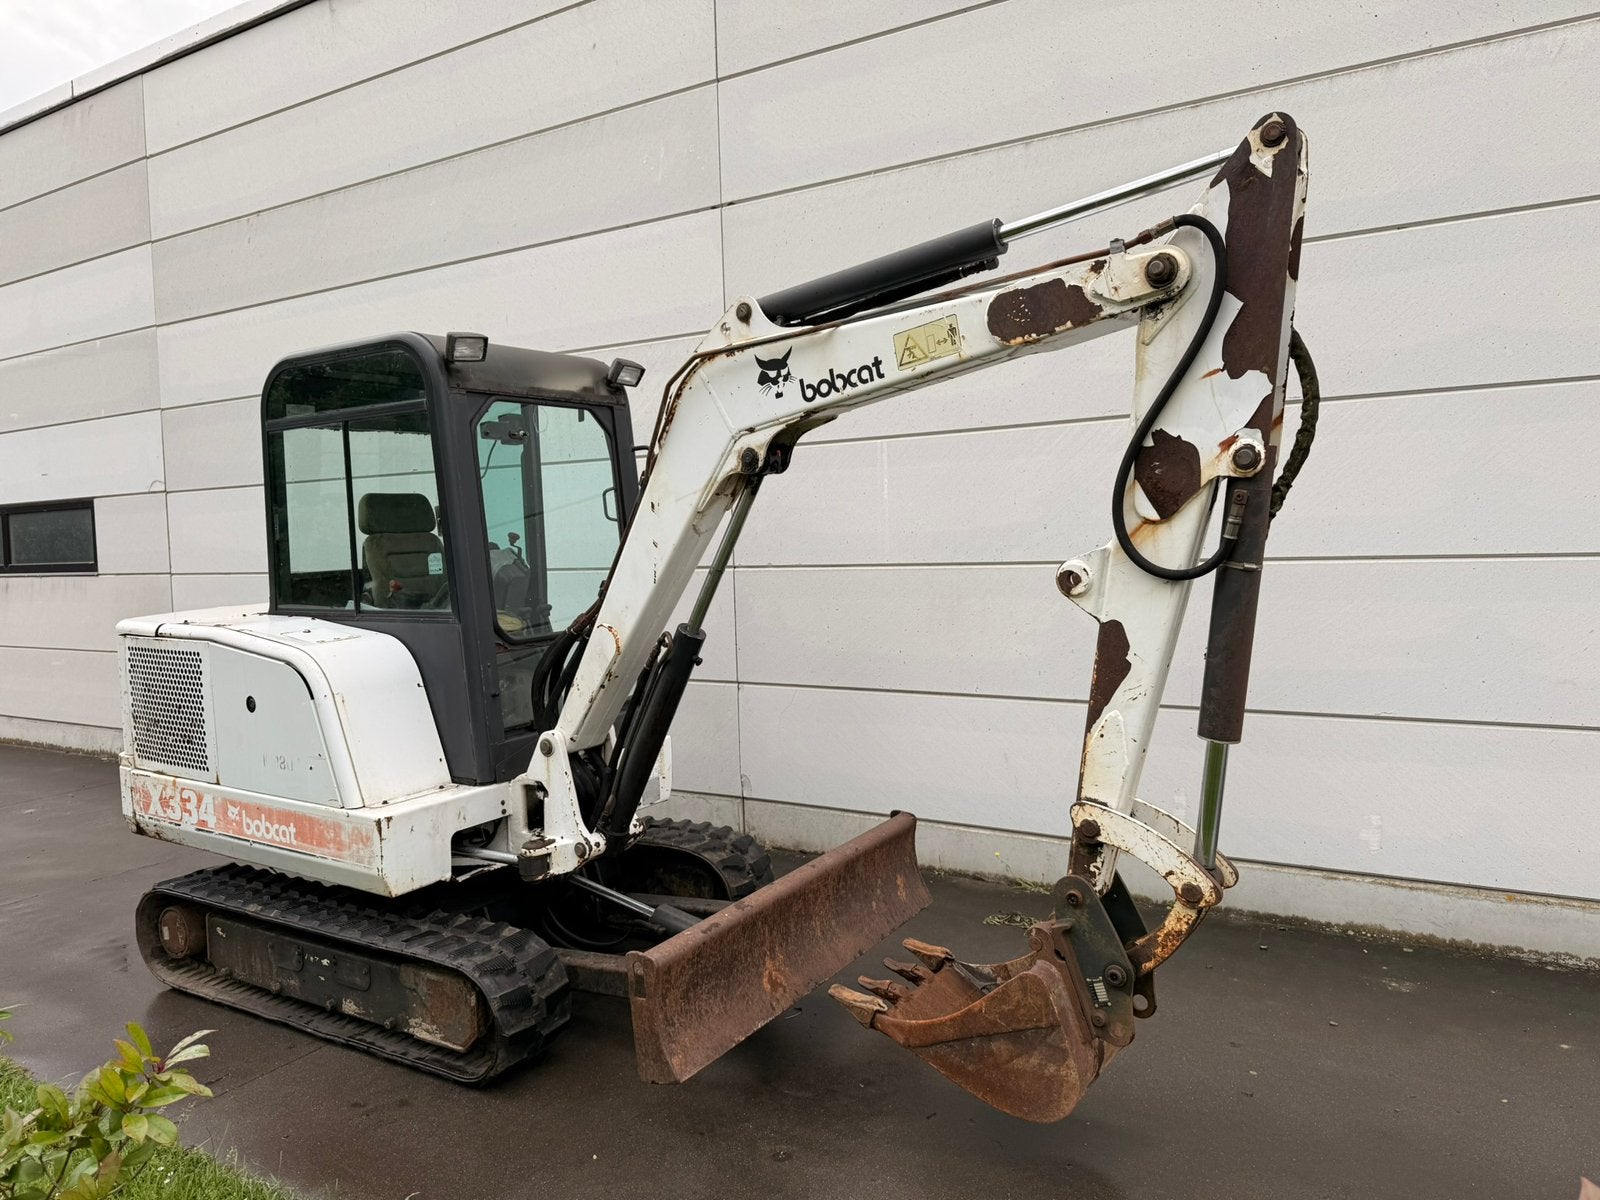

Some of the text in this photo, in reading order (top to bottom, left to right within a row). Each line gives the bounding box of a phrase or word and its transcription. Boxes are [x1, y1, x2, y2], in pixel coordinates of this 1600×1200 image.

[800, 357, 885, 402] bobcat
[147, 784, 296, 844] X334 bobcat
